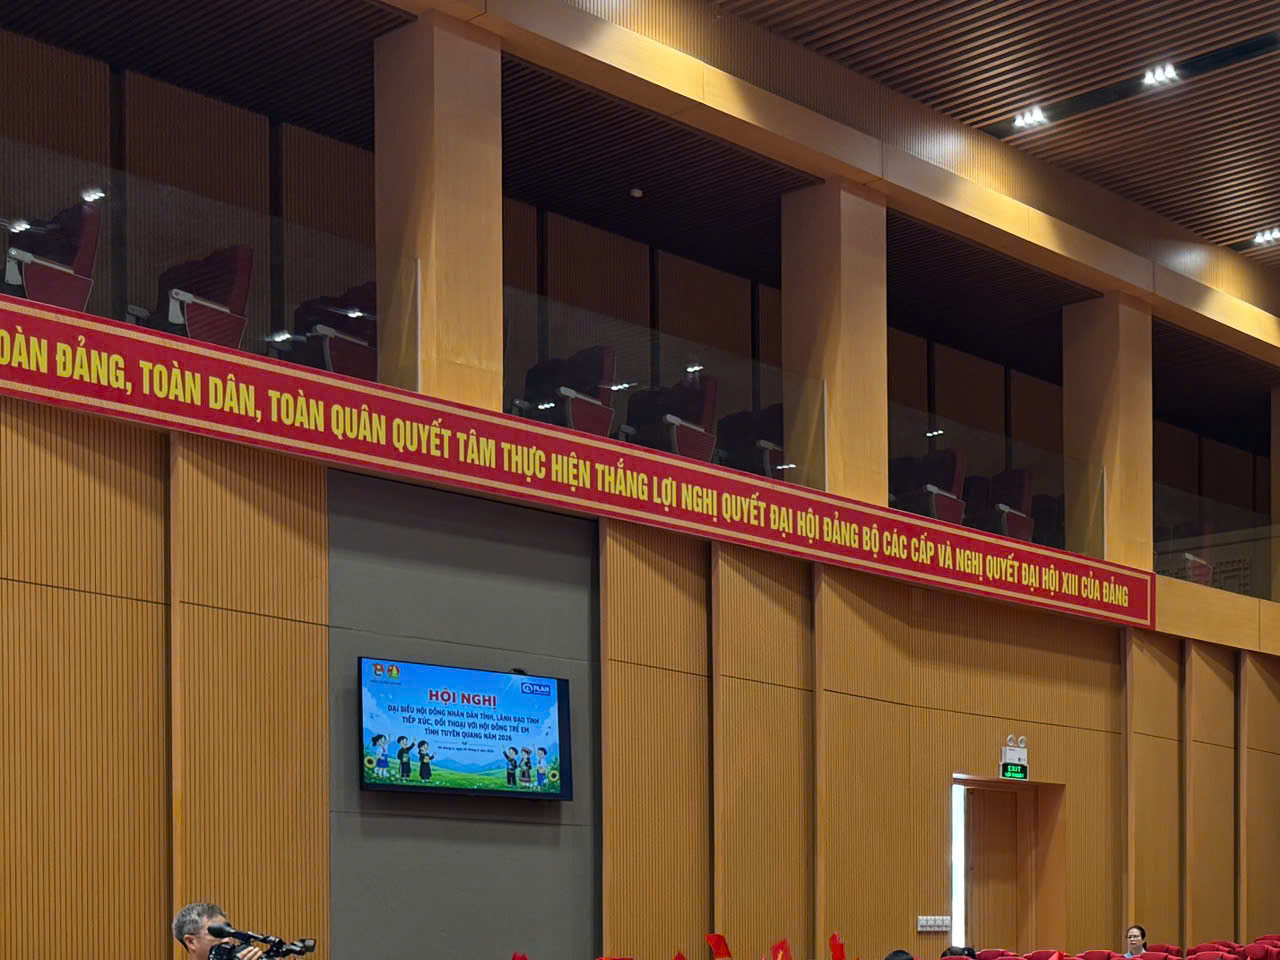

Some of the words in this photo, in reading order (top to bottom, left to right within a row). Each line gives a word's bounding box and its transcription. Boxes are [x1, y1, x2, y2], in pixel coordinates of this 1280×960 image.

[56, 335, 133, 395] ĐẢNG,
[139, 360, 201, 406] TOÀN
[209, 374, 262, 422] DÂN,
[268, 389, 324, 432] TOÀN
[331, 404, 386, 445] QUÂN
[392, 418, 452, 458] QUYẾT
[457, 428, 496, 469] TÂM
[501, 441, 546, 483] THỰC
[551, 451, 590, 492] HIỆN
[595, 457, 648, 501] THẮNG
[653, 476, 677, 512] LỢI
[681, 483, 718, 522] NGHỊ
[722, 492, 767, 527] QUYẾT
[770, 504, 793, 537] ĐẠI
[797, 508, 819, 543] HỘI
[823, 511, 859, 549] ĐẢNG
[862, 523, 879, 559] BỘ
[882, 529, 908, 559] CÁC
[911, 532, 934, 564] CẤP
[937, 541, 953, 569] VÀ
[956, 548, 983, 581] NGHỊ
[986, 553, 1019, 584] QUYẾT
[1021, 562, 1039, 592] ĐẠI
[1042, 564, 1059, 596] HỘI
[1062, 571, 1078, 596] XIII
[1081, 570, 1100, 601] CỦA
[1102, 576, 1129, 608] ĐẢNG
[429, 688, 456, 705] HỘI
[461, 692, 496, 710] NGHỊ
[461, 731, 482, 739] QUANG
